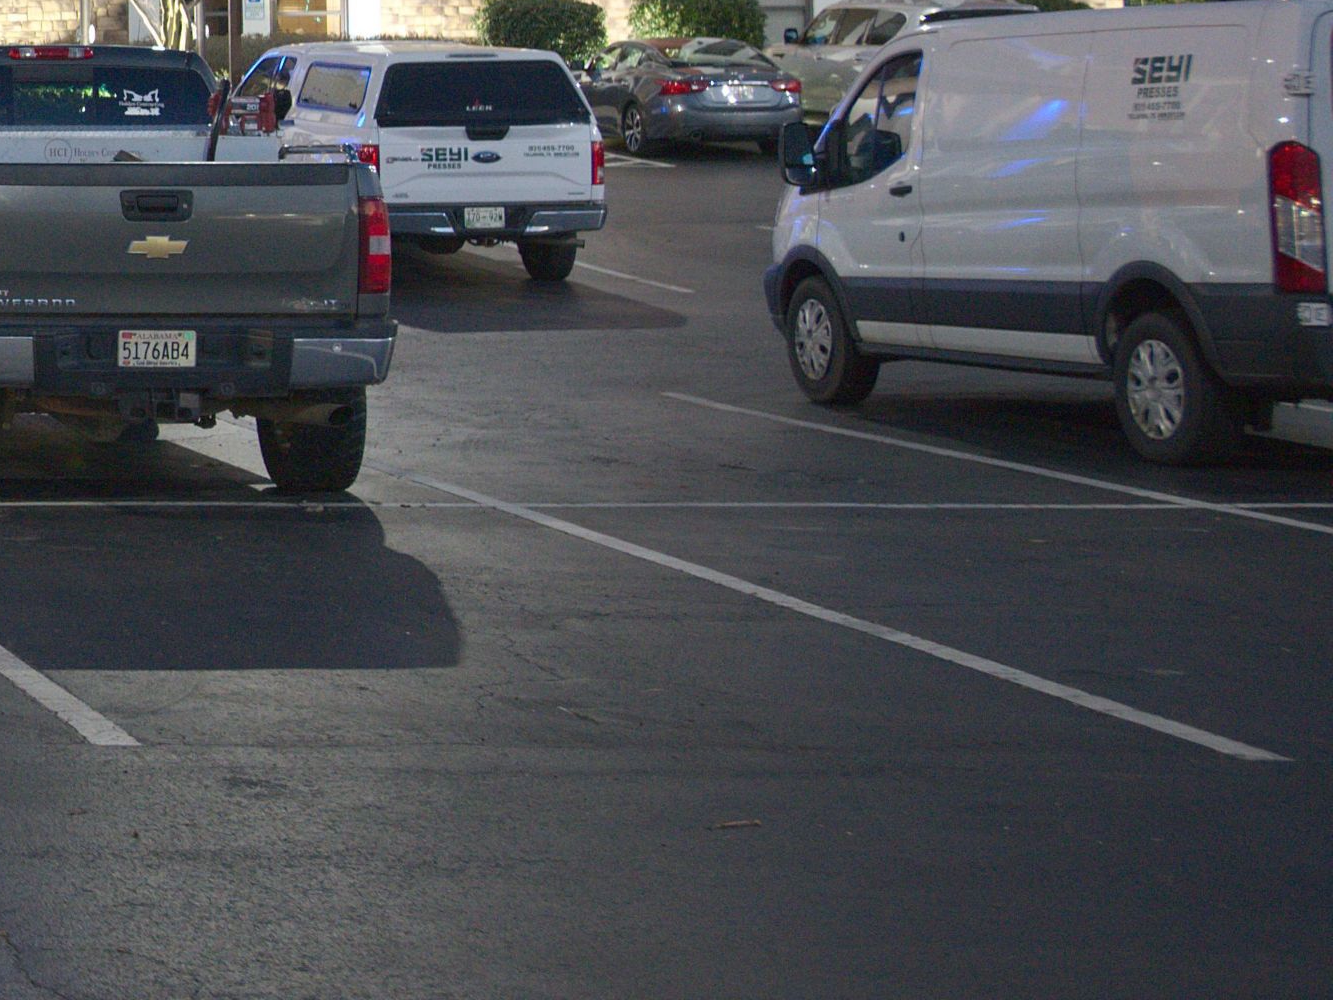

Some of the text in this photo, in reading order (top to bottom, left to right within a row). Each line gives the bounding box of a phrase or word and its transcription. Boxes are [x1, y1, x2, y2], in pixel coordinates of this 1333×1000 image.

[1131, 54, 1193, 85] SEYI
[1137, 86, 1179, 99] PRESSES
[49, 147, 68, 157] HCI
[420, 147, 469, 162] SEYI
[123, 342, 190, 360] 5176AB4
